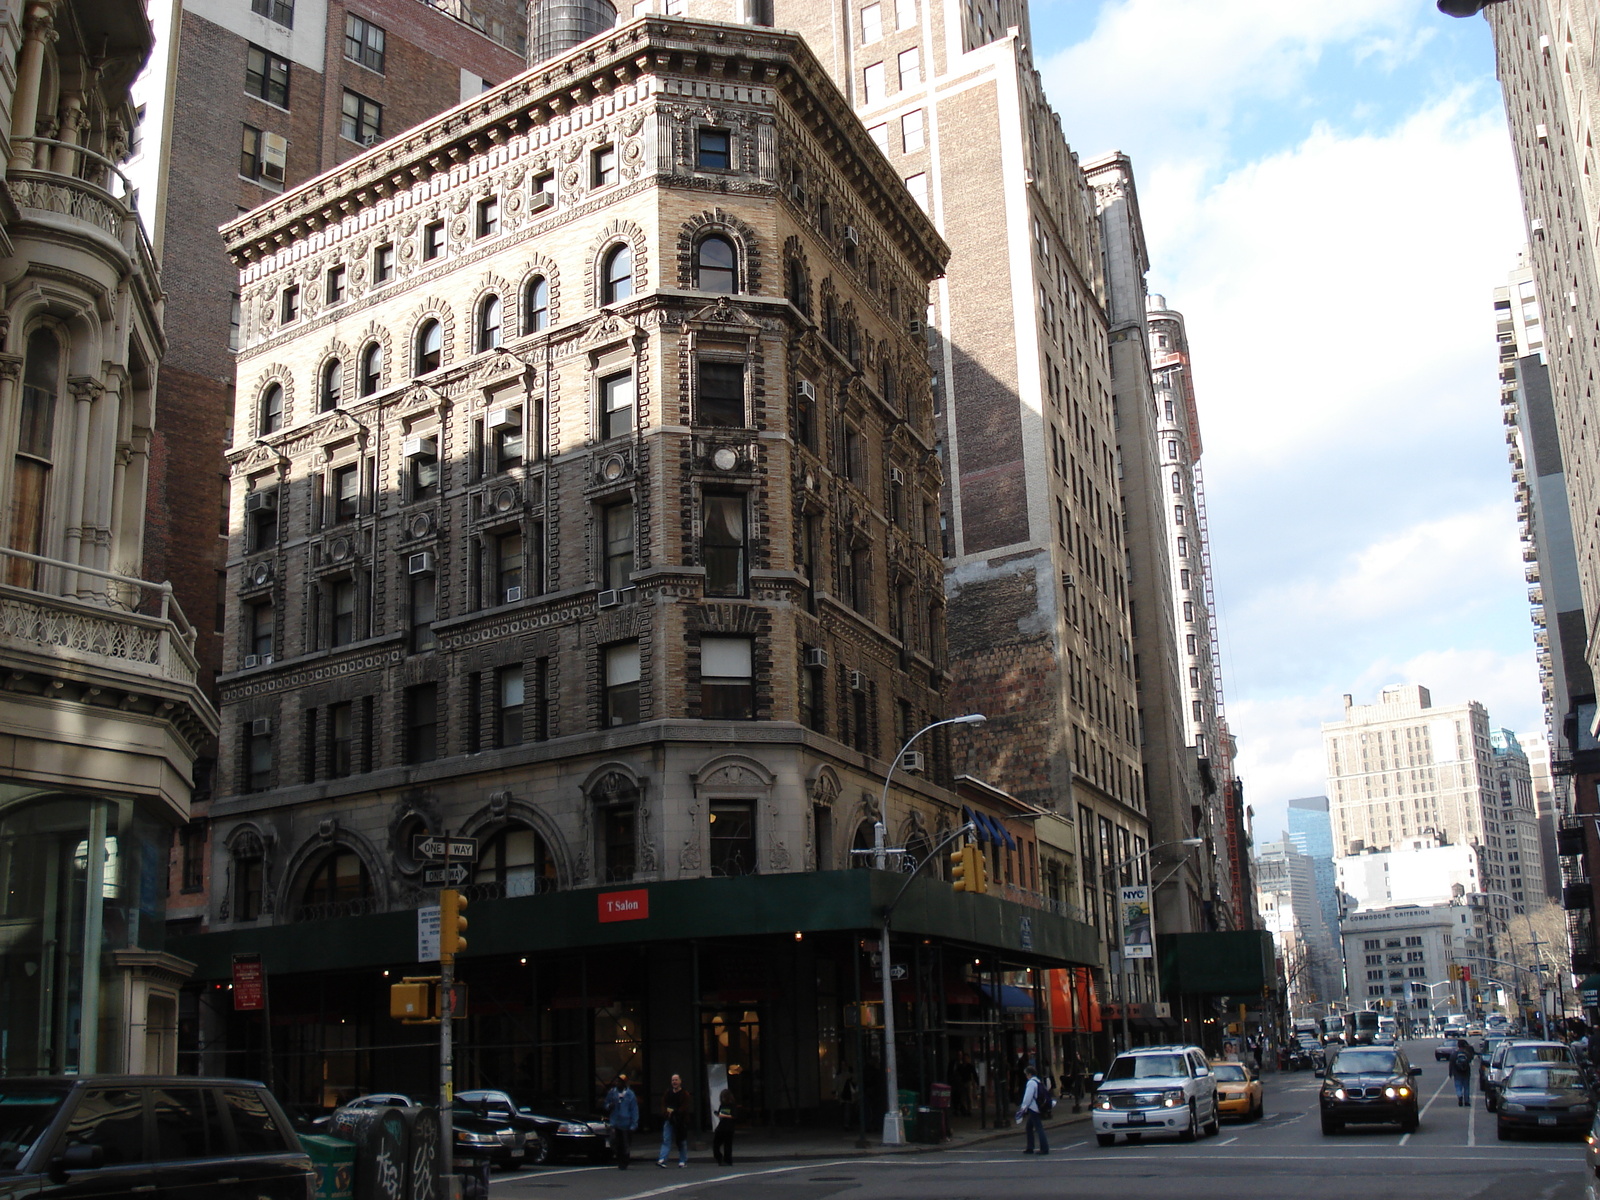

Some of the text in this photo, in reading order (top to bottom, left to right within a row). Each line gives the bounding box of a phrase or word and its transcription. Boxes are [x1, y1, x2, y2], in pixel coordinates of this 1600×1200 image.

[424, 843, 471, 855] ONE WAY
[429, 869, 464, 881] ONE WAY
[1123, 891, 1144, 899] NYC
[607, 899, 639, 912] T Salon
[1349, 910, 1430, 922] COMMODORE CRITERION
